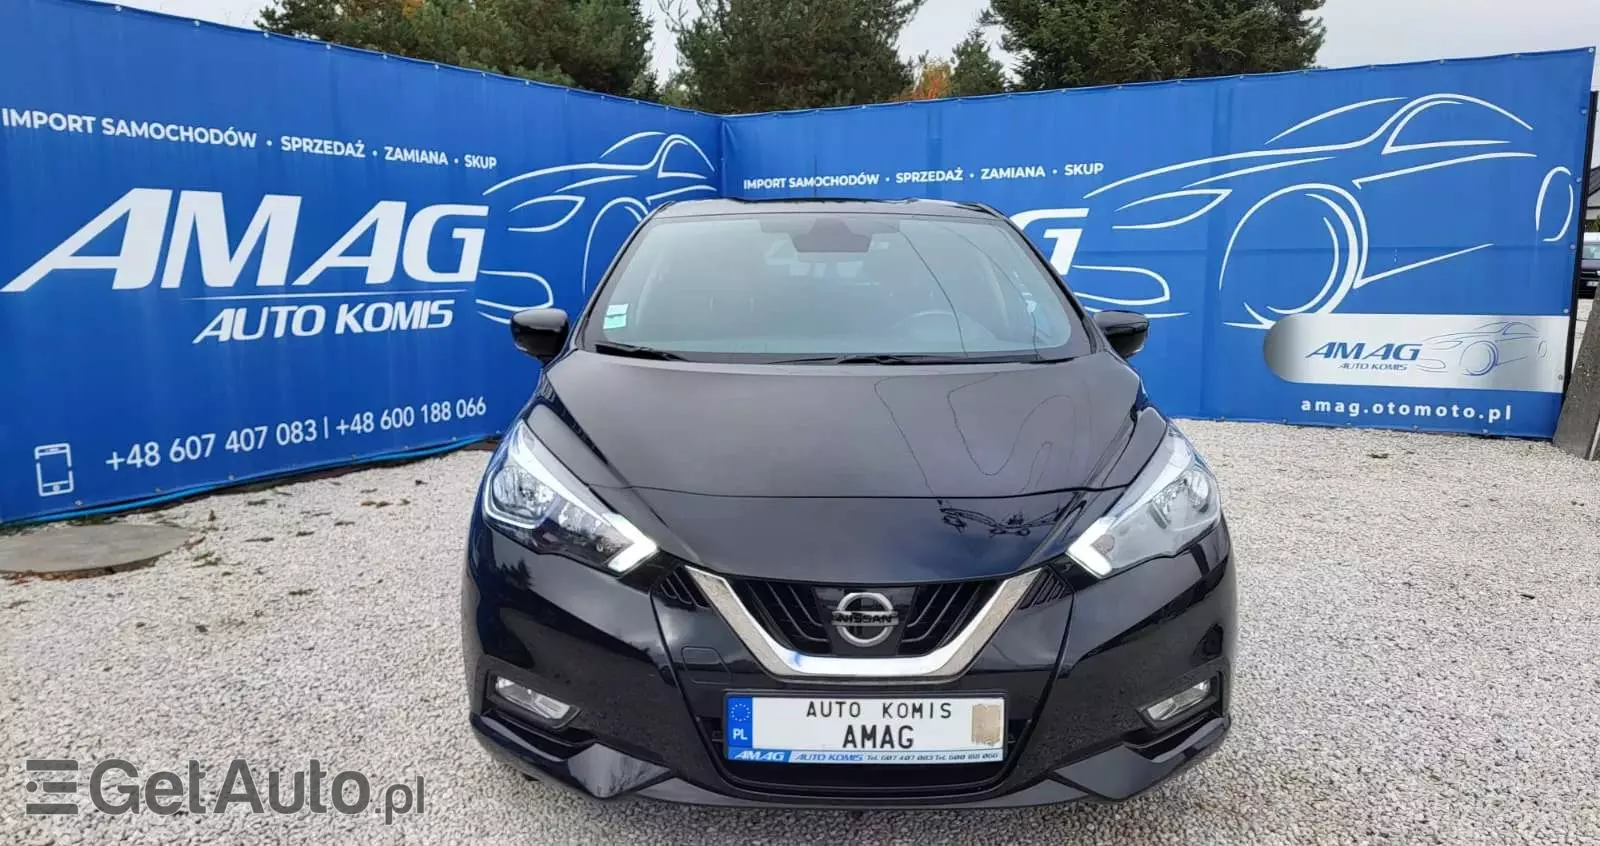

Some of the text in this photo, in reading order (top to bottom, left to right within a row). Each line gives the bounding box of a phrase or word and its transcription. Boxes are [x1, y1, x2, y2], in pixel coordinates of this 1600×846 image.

[2, 107, 498, 169] IMPORT SAMOCHODÓW SPRZEDAŻ ZAMIANA SKUP
[743, 162, 1104, 190] IMPORT SAMOCHODÓW SPRZEDAŻ ZAMIANA SKUP
[192, 300, 454, 344] AUTO KOMIS
[1338, 362, 1408, 371] AUTO KOMIS
[1301, 399, 1512, 422] amag.otomoto.pl
[105, 396, 487, 472] +48 607 407 083 +48 600 188 066
[834, 613, 893, 624] NISSAN
[806, 701, 952, 719] AUTO KOMIS
[733, 728, 748, 741] PL
[842, 725, 915, 749] AMAG
[796, 753, 826, 761] AUTO
[828, 753, 863, 762] KOMIS
